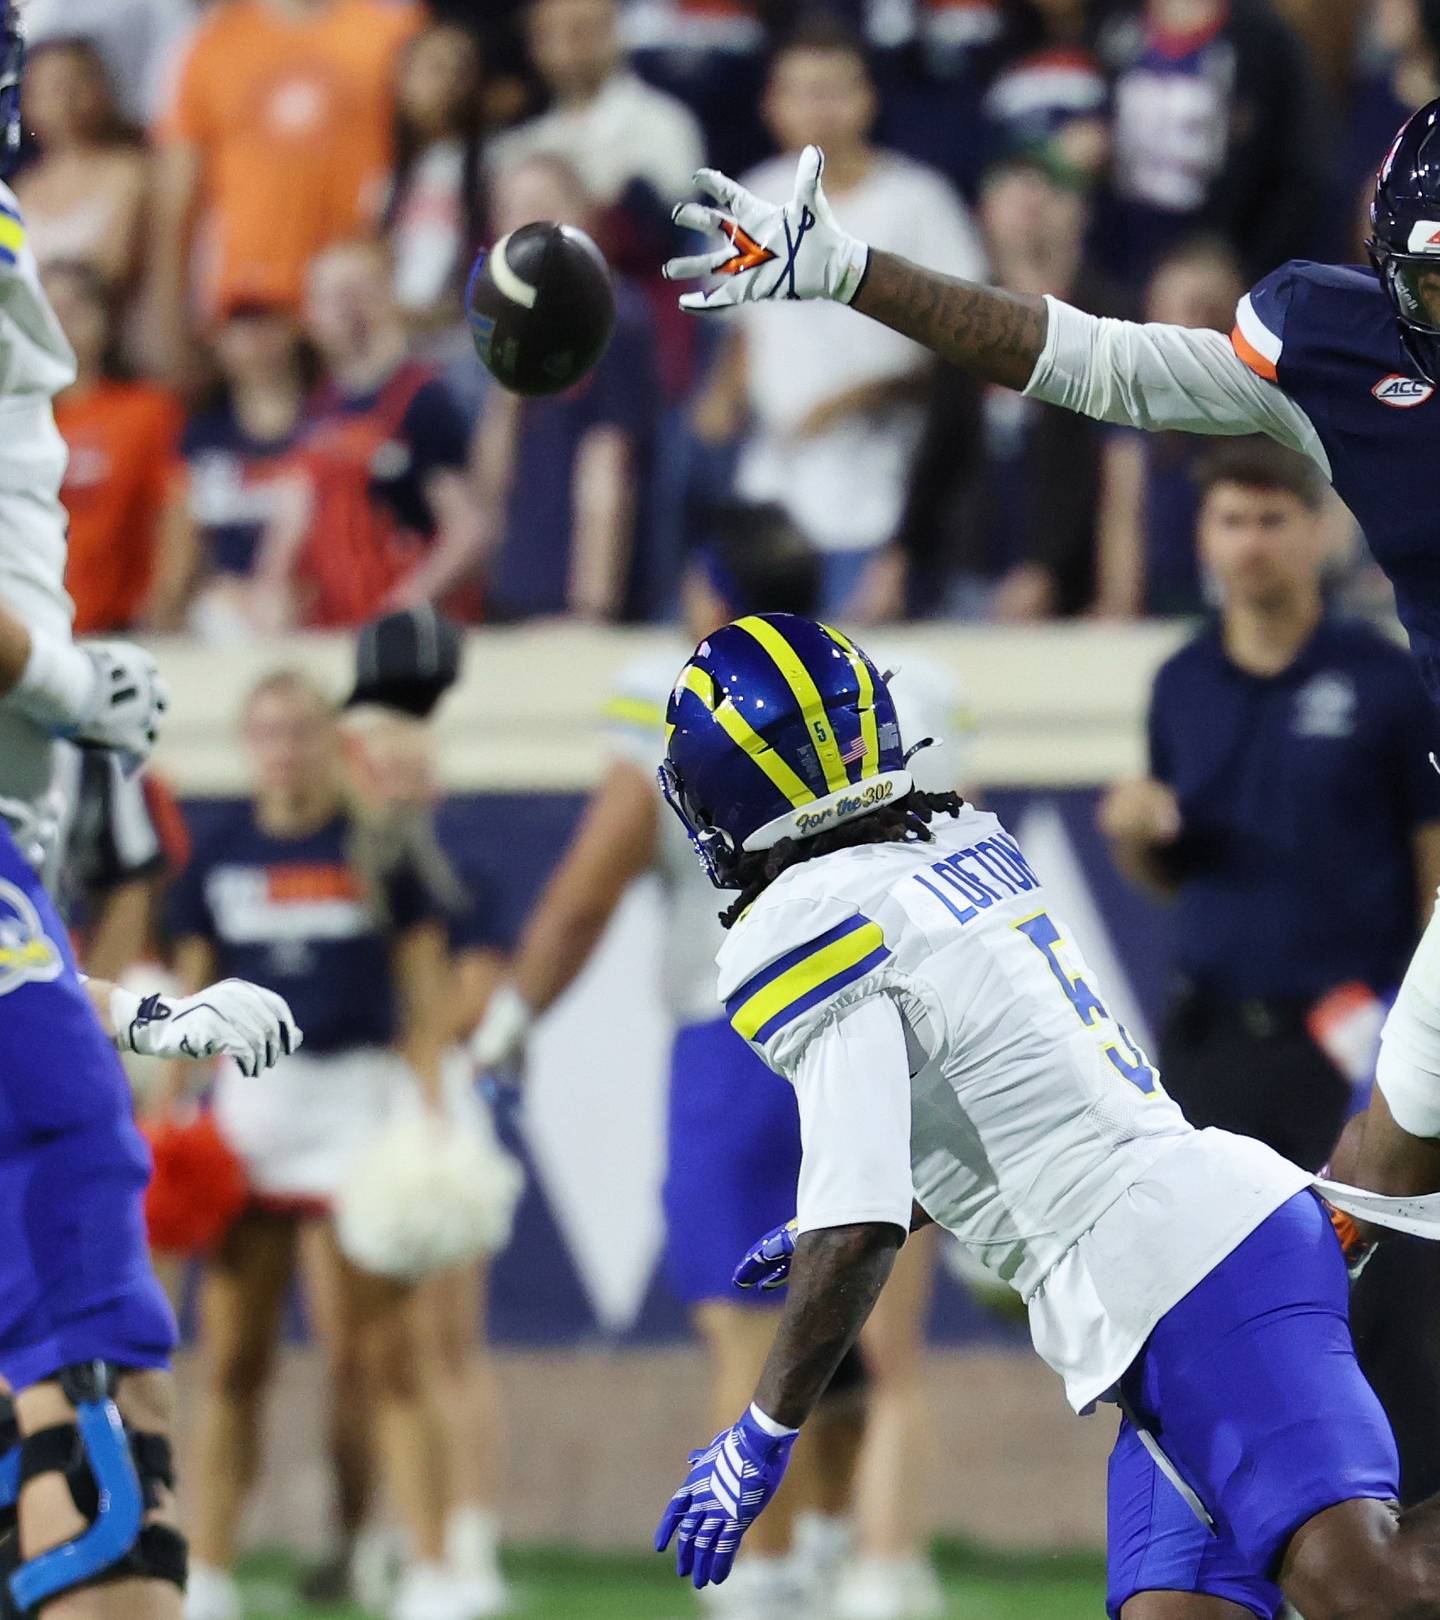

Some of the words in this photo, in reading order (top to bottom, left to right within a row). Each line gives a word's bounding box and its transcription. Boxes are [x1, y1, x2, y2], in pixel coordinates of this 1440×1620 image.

[1382, 380, 1424, 395] ACC
[813, 721, 827, 742] 5
[796, 808, 833, 834] For
[836, 796, 862, 817] the
[863, 781, 893, 808] 302
[913, 832, 1041, 925] LOFTON
[1009, 907, 1161, 1099] 5
